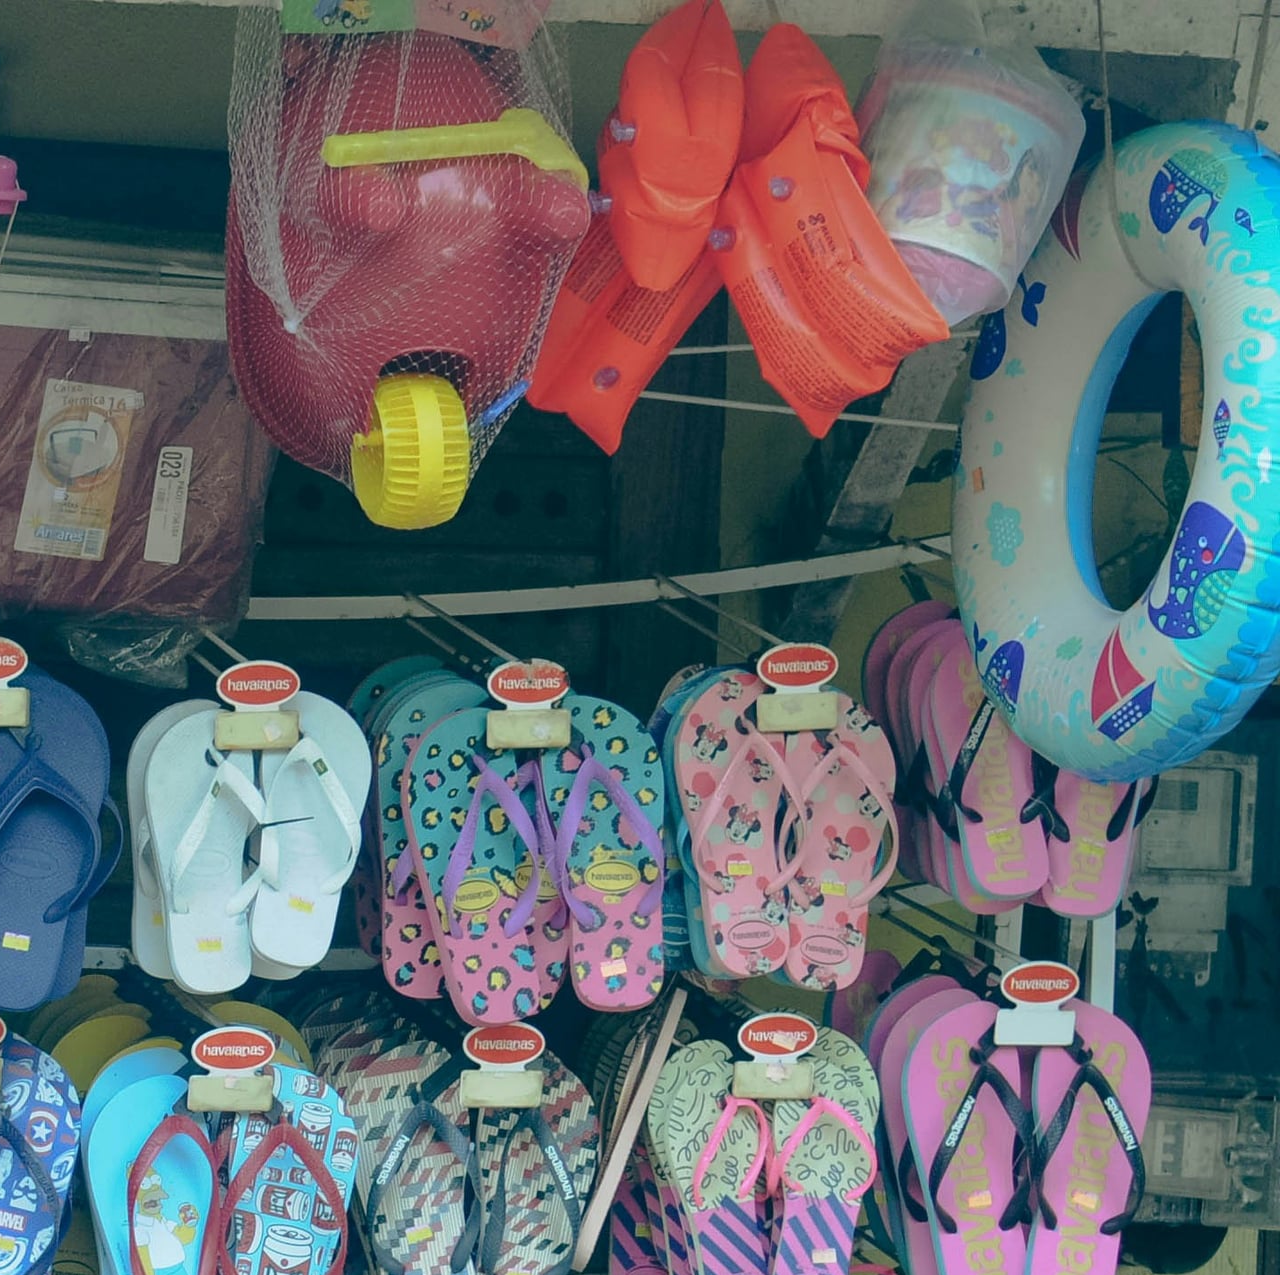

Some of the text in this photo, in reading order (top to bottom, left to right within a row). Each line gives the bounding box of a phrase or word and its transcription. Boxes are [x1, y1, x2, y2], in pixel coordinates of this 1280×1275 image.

[159, 451, 183, 479] 023
[768, 659, 829, 674] havaianas
[228, 678, 293, 693] havaianas
[1011, 977, 1071, 991] havaianas
[203, 1043, 265, 1058] havaianas
[474, 1038, 535, 1052] havaianas
[946, 1095, 976, 1148] havaianas
[1104, 1095, 1137, 1151] havaianas
[376, 1133, 410, 1187] havaianas
[544, 1145, 573, 1201] havaianas
